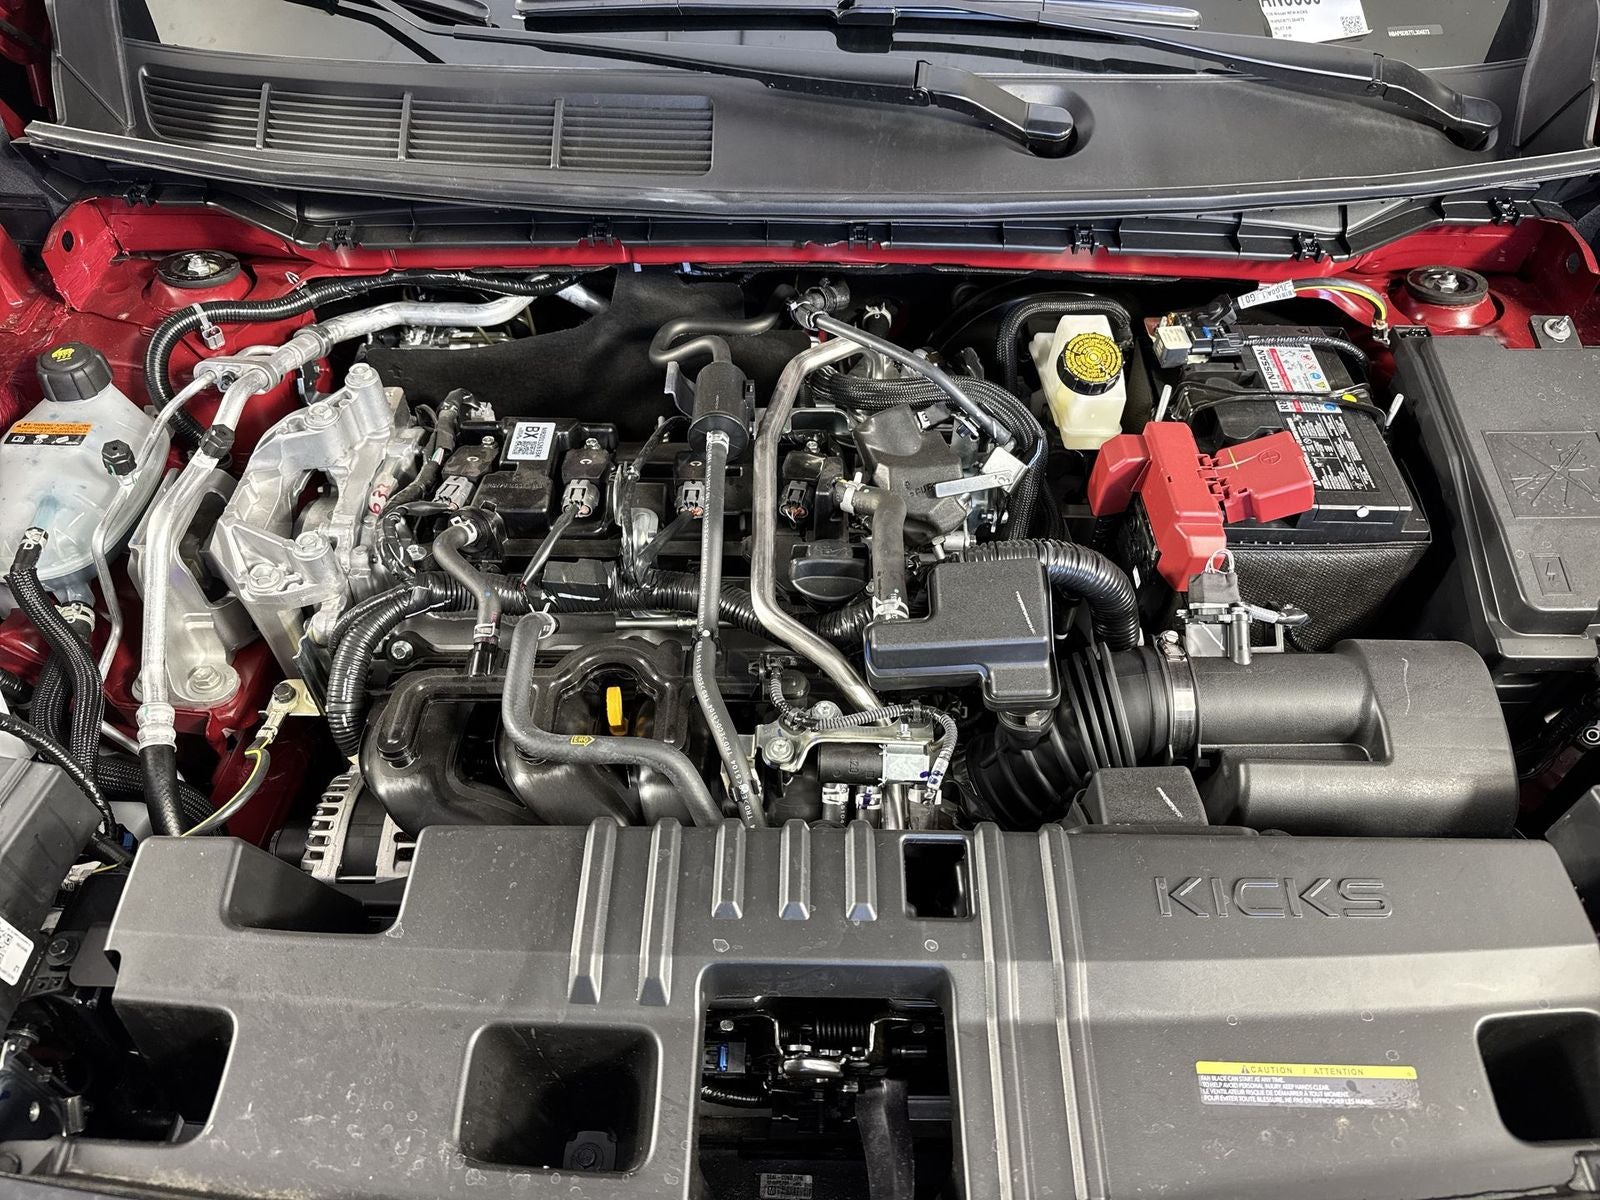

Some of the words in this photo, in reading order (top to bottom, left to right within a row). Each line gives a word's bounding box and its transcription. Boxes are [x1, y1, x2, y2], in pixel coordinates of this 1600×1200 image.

[1258, 349, 1276, 380] NISSAN
[525, 425, 540, 439] BX
[1153, 876, 1393, 918] KICKS
[1250, 1065, 1293, 1075] CAUTION
[1312, 1066, 1364, 1076] ATTENTION
